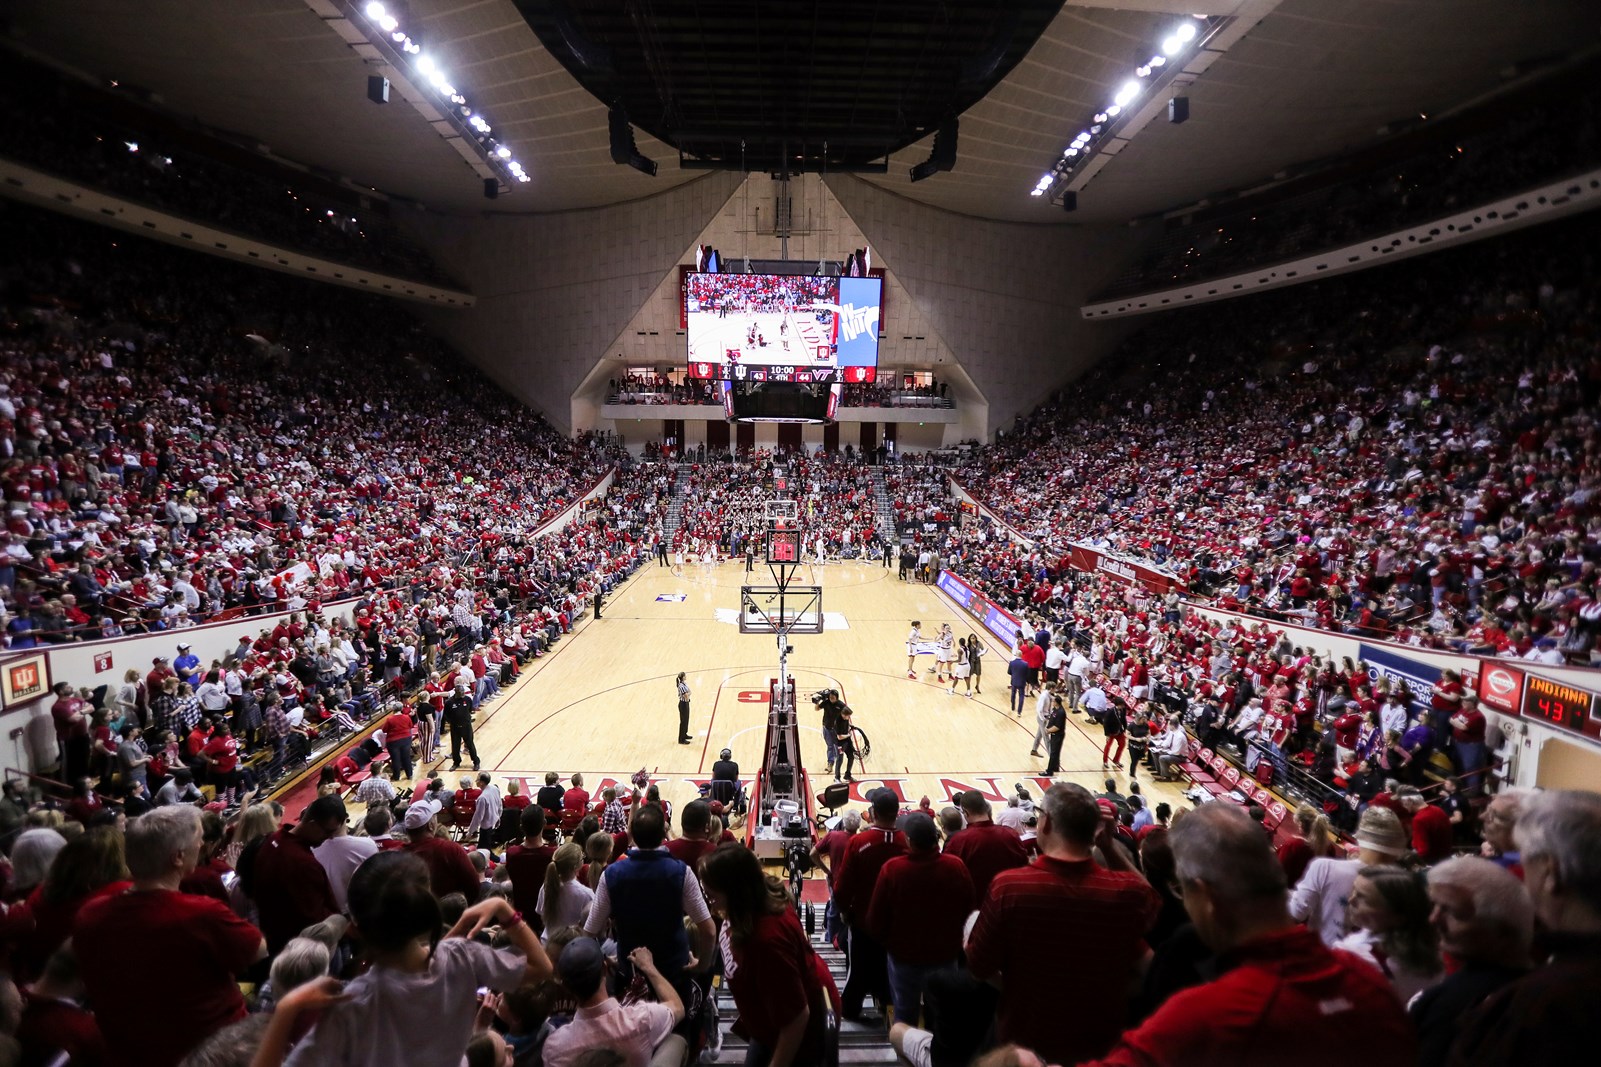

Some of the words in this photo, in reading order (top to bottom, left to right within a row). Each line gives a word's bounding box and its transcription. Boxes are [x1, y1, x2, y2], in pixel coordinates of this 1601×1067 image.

[753, 372, 764, 380] 43
[771, 366, 795, 374] 10:00
[812, 369, 834, 381] VT
[1103, 558, 1120, 573] Credit
[1119, 562, 1136, 579] Union
[100, 659, 108, 670] 8
[1405, 678, 1435, 696] SPOR
[1465, 677, 1473, 688] 4
[13, 685, 41, 698] HEALTH
[1530, 677, 1588, 706] INDIANA
[1538, 698, 1563, 721] 43
